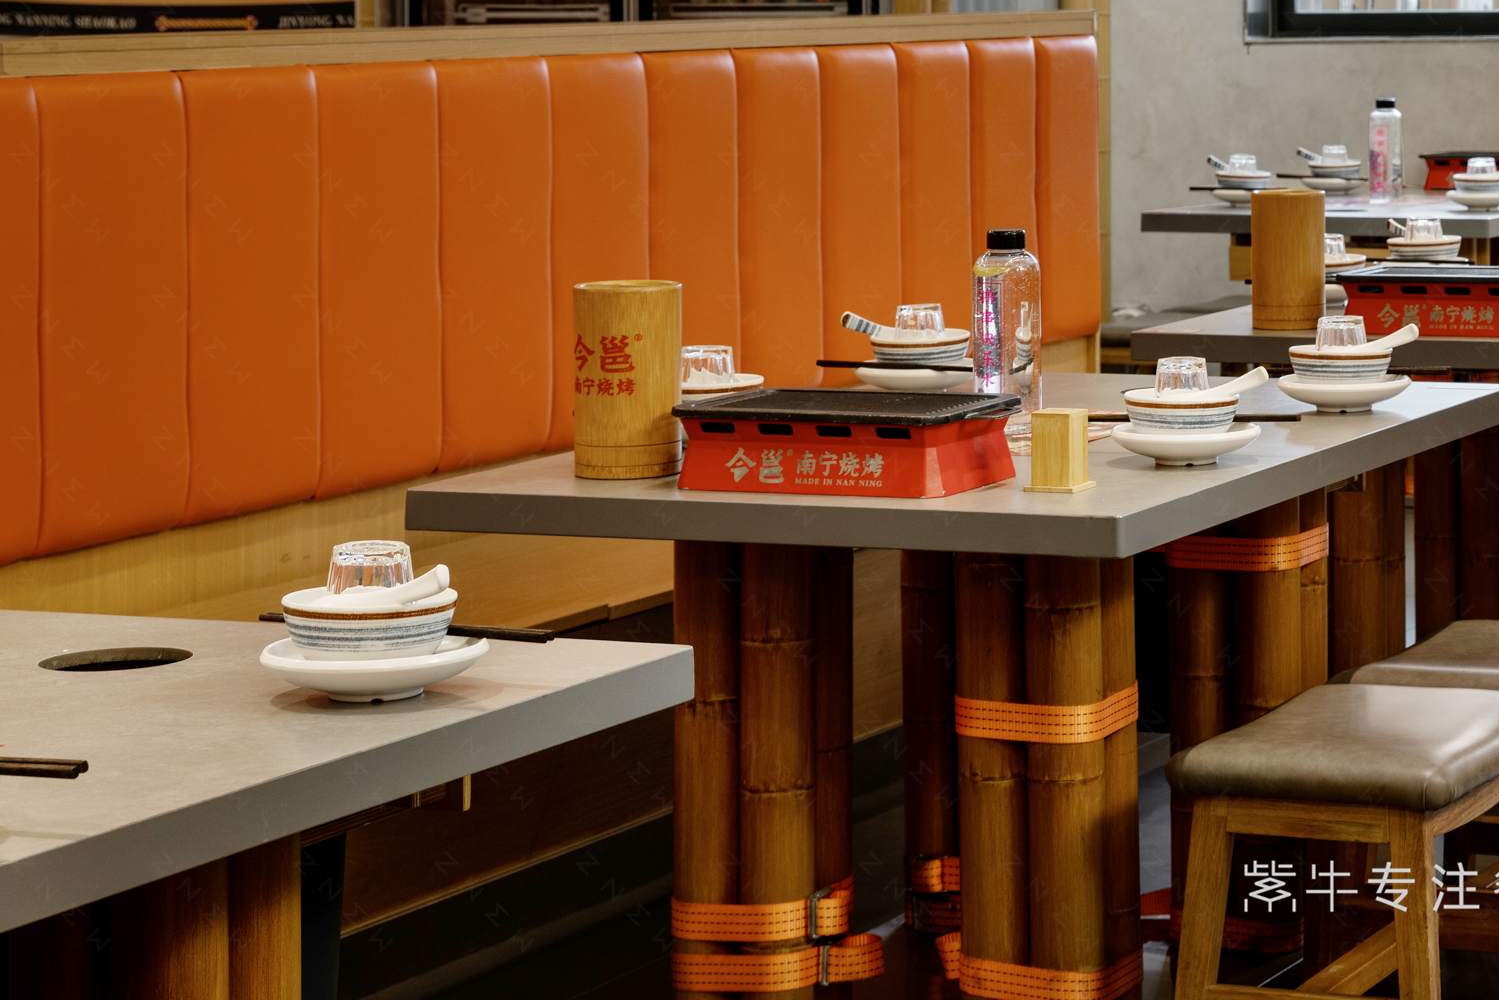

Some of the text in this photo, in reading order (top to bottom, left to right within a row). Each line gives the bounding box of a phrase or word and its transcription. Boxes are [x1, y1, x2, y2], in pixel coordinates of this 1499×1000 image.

[1430, 305, 1494, 324] 南宁烧烤
[574, 333, 635, 373] 今邕
[725, 447, 884, 484] 今邕 南宁烧烤
[795, 477, 883, 488] MADE IN NAN NING
